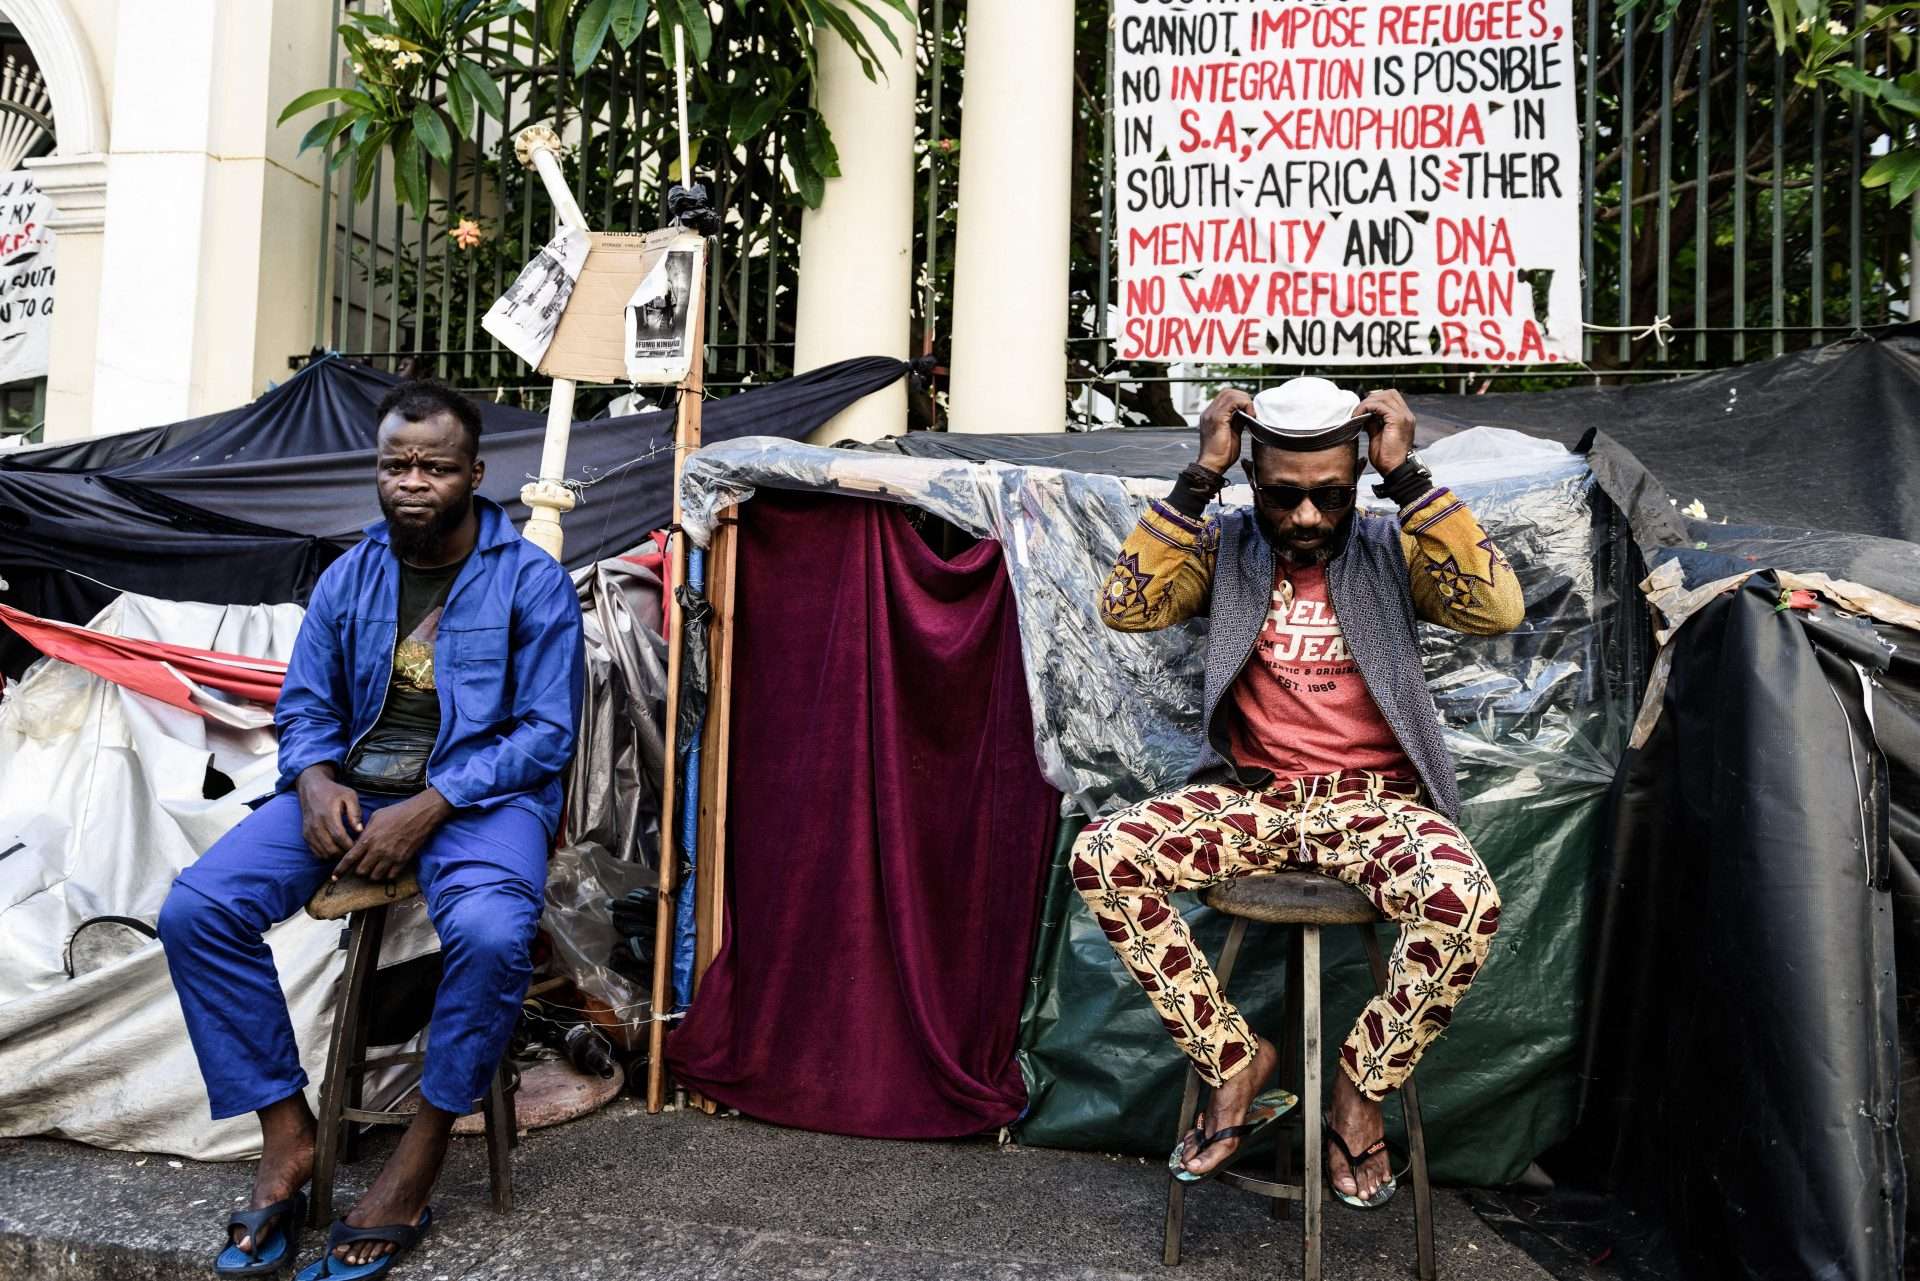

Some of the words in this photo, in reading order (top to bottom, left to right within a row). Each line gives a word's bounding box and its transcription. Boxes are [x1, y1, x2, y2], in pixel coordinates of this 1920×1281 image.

[1122, 11, 1238, 57] CANNOT
[1250, 6, 1367, 52] IMPOSE
[1377, 0, 1565, 46] REFUGEES,
[1122, 65, 1161, 107] NO
[1170, 58, 1365, 104] INTEGRATION
[1374, 55, 1405, 97] IS
[1413, 42, 1562, 96] POSSIBLE
[1124, 115, 1153, 157] IN
[1257, 102, 1486, 151] XENOPHOBIA
[1513, 98, 1545, 140] IN
[1410, 154, 1441, 202] IS
[1458, 151, 1563, 200] THEIR
[1128, 217, 1326, 267] MENTALITY
[1343, 216, 1414, 267] AND
[1435, 215, 1517, 267] DNA
[1125, 274, 1166, 317] NO
[1178, 272, 1261, 317] WAY
[1266, 270, 1420, 319] REFUGEE
[1436, 268, 1515, 319] CAN
[1123, 316, 1261, 360] SURVIVE
[1281, 318, 1326, 358] NO
[1332, 320, 1423, 359] MORE
[1440, 319, 1560, 363] R.S.A.
[1274, 625, 1353, 662] JEA
